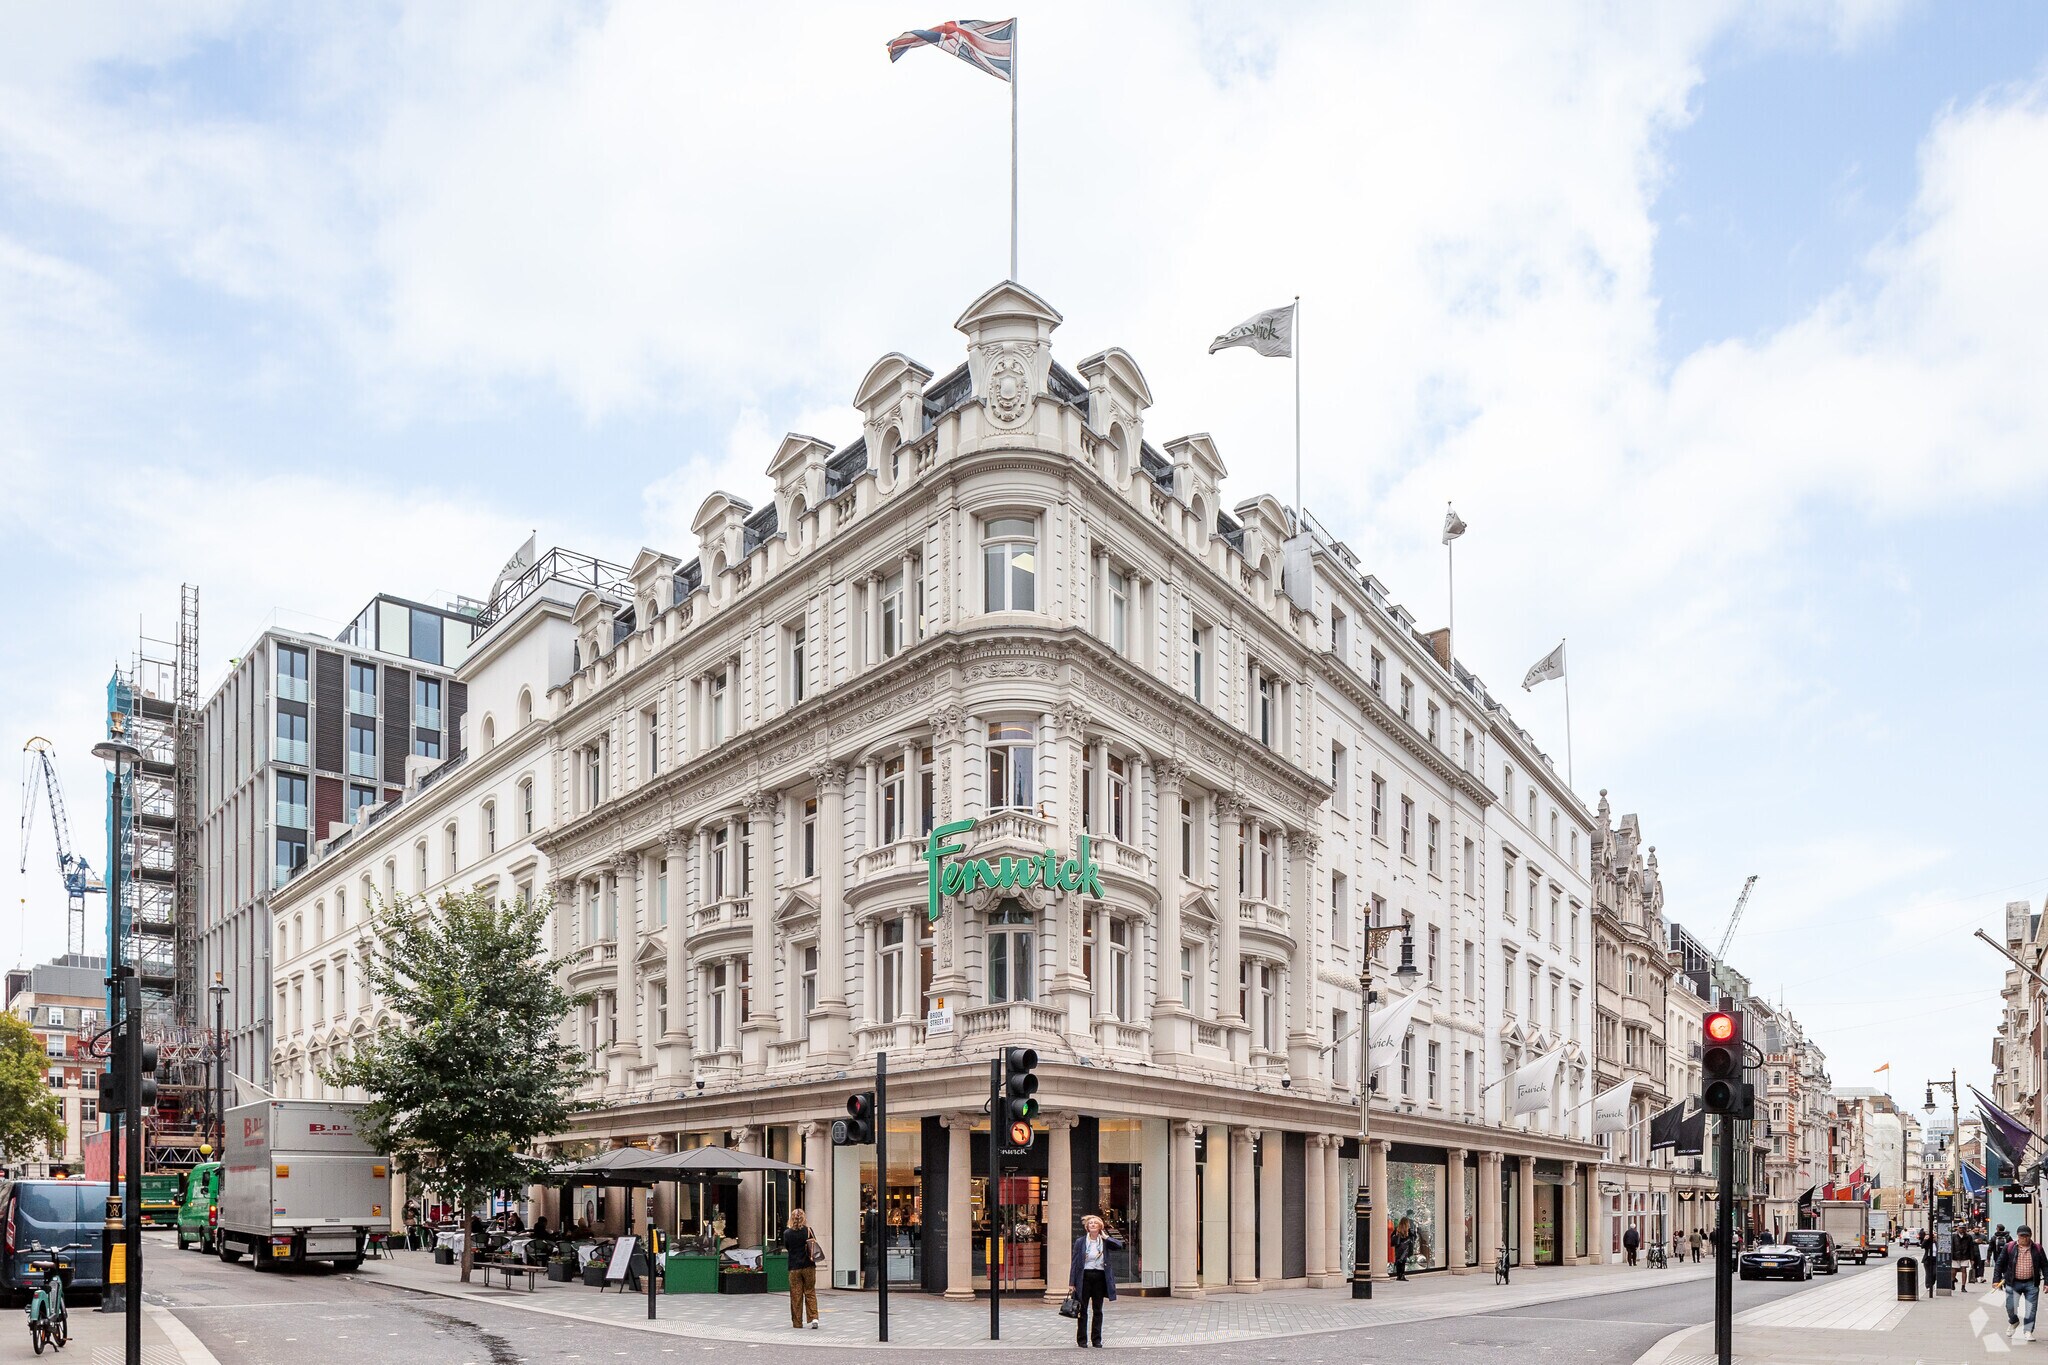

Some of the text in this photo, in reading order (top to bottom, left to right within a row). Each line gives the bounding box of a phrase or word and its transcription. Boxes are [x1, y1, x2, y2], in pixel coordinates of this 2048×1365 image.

[922, 817, 1106, 922] Fenwick
[930, 1011, 943, 1019] BROOK
[930, 1018, 944, 1026] STREET
[1369, 1035, 1394, 1049] wick
[1518, 1083, 1547, 1099] Fenwick
[1596, 1109, 1624, 1121] Fenwick
